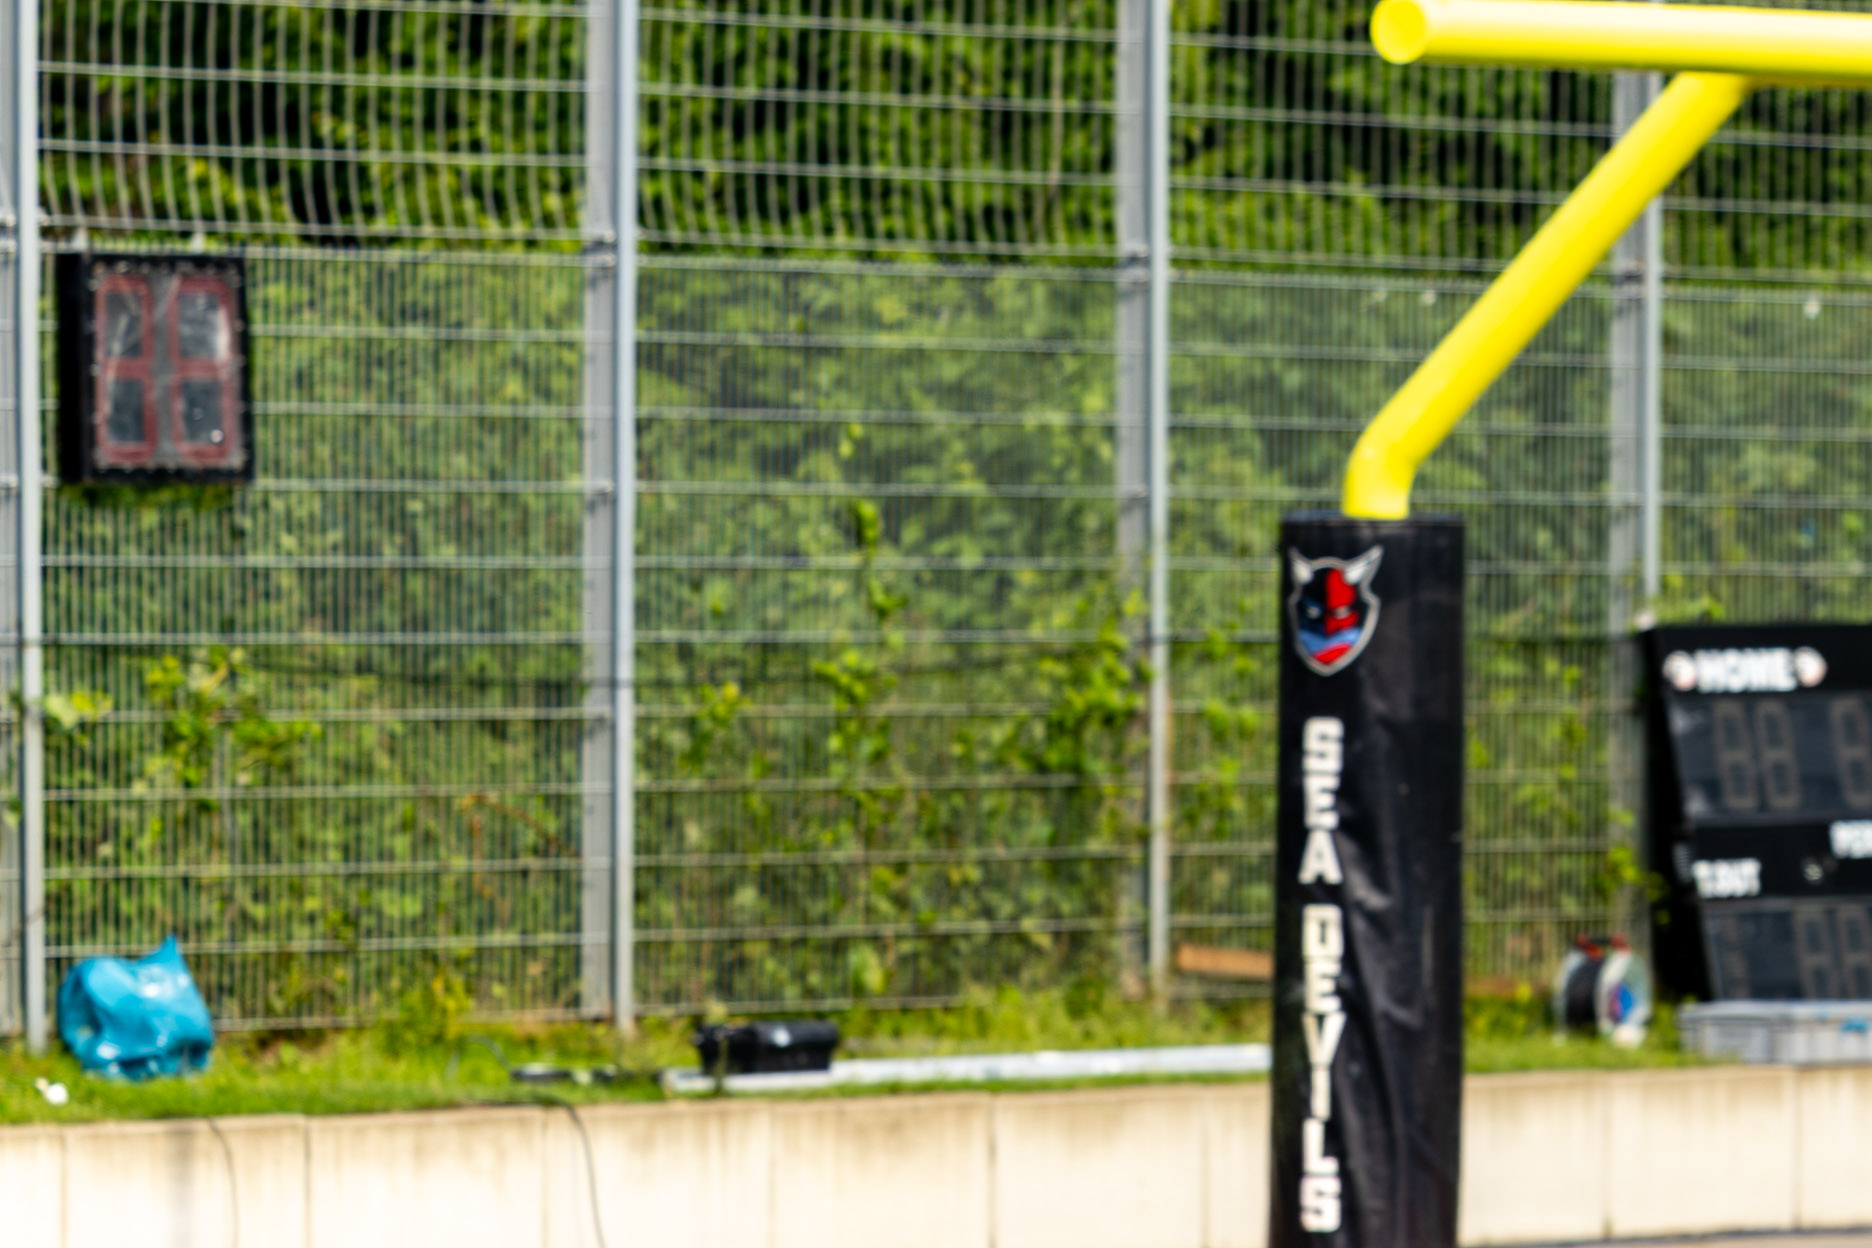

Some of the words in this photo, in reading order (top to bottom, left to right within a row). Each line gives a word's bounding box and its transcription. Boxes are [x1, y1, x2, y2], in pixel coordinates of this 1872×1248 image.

[1694, 647, 1797, 693] HOME
[1298, 716, 1344, 884] SEA
[1300, 904, 1346, 1232] DEVILS
